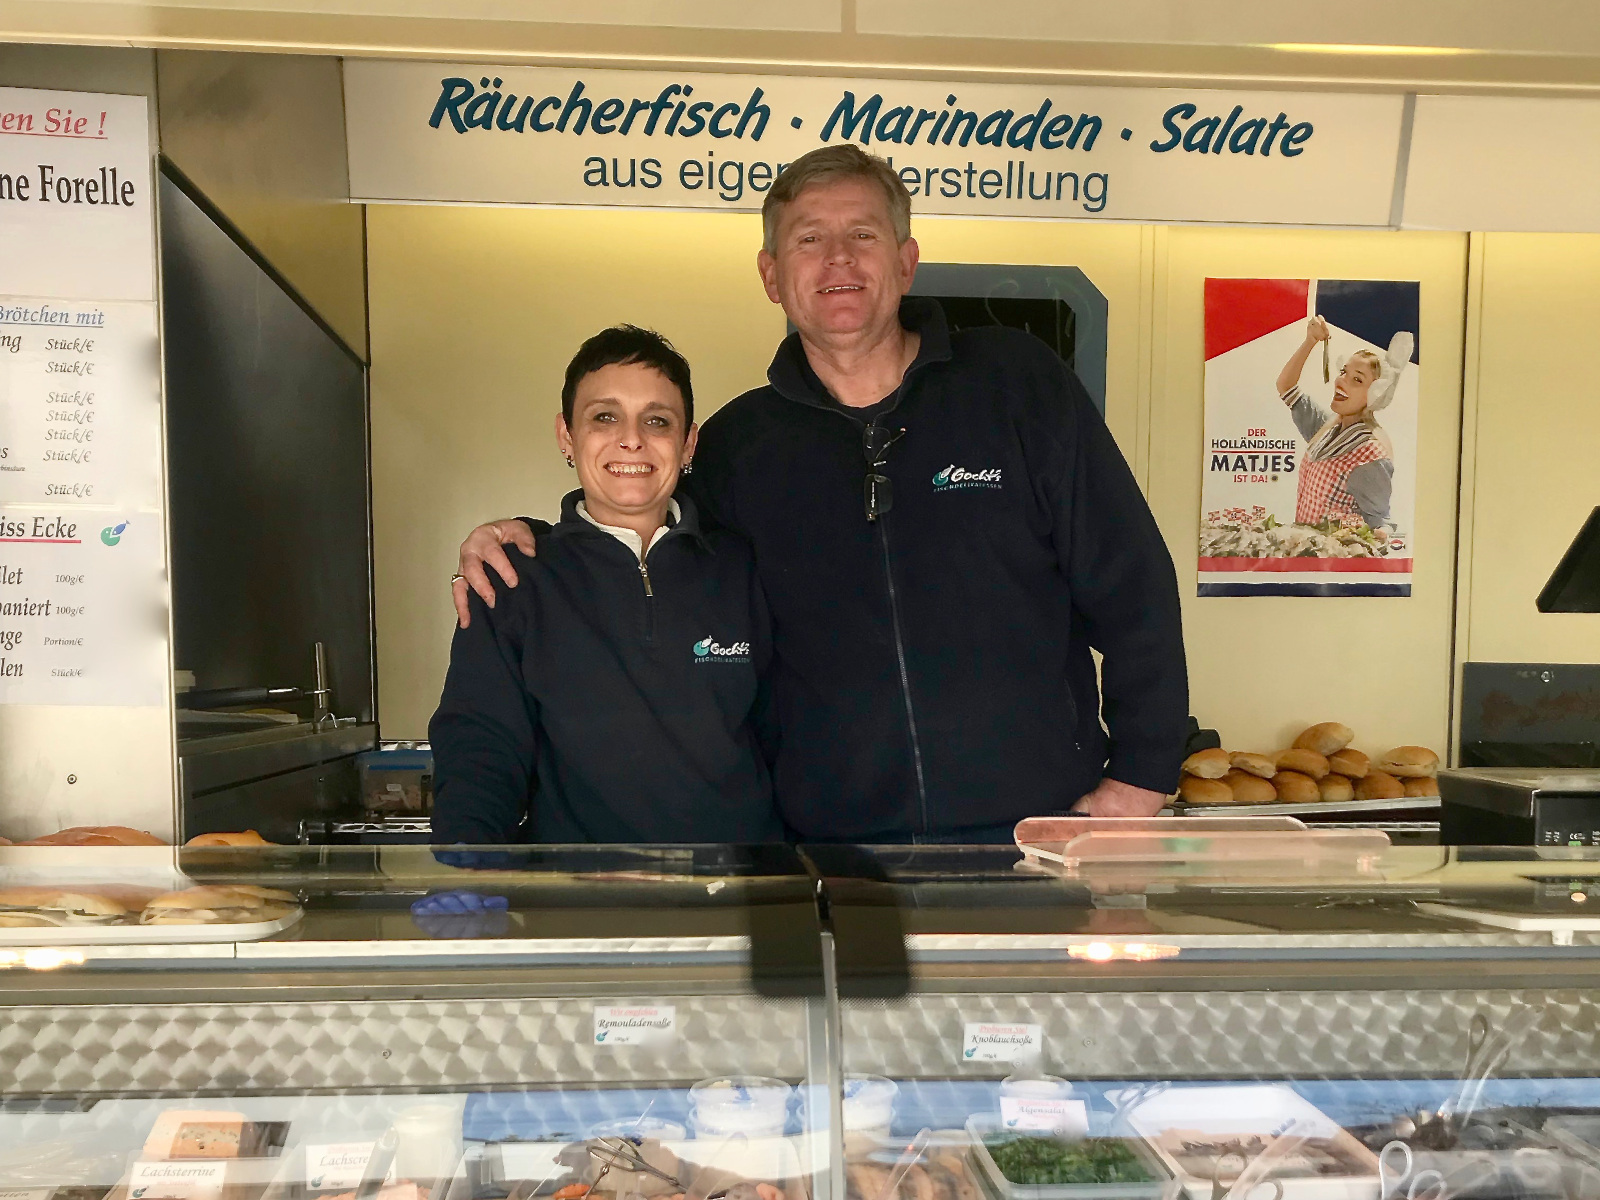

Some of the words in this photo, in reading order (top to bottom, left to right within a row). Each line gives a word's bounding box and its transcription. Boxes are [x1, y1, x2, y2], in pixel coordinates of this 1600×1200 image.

[0, 112, 35, 132] en
[44, 107, 88, 134] Sie
[428, 76, 772, 142] Räucherfisch
[819, 90, 1103, 153] Marinaden
[1149, 102, 1314, 158] Salate
[37, 164, 135, 207] Forelle
[582, 155, 663, 189] aus
[679, 150, 792, 202] eige
[887, 156, 1109, 213] erstellung
[76, 307, 105, 326] mit
[45, 338, 95, 354] Stück/€
[45, 361, 95, 377] Stück/€
[46, 391, 95, 407] Stück/€
[45, 409, 95, 425] Stück/€
[44, 428, 94, 444] Stück/€
[1247, 428, 1267, 437] DER
[1211, 436, 1296, 450] HOLLÄNDISCHE
[43, 449, 92, 464] Stück/€
[1210, 454, 1296, 473] MATJES
[1233, 474, 1249, 483] IST
[1250, 474, 1268, 483] DA!
[44, 483, 94, 498] Stück/€
[32, 516, 77, 538] Ecke
[0, 564, 24, 585] let
[55, 574, 85, 586] 100g/€
[55, 606, 85, 618] 100g/€
[43, 637, 83, 646] Portion/€
[598, 1017, 672, 1029] Remouladensoße
[971, 1033, 1033, 1046] Knoblauchsoße
[140, 1164, 216, 1178] Lachsterrine
